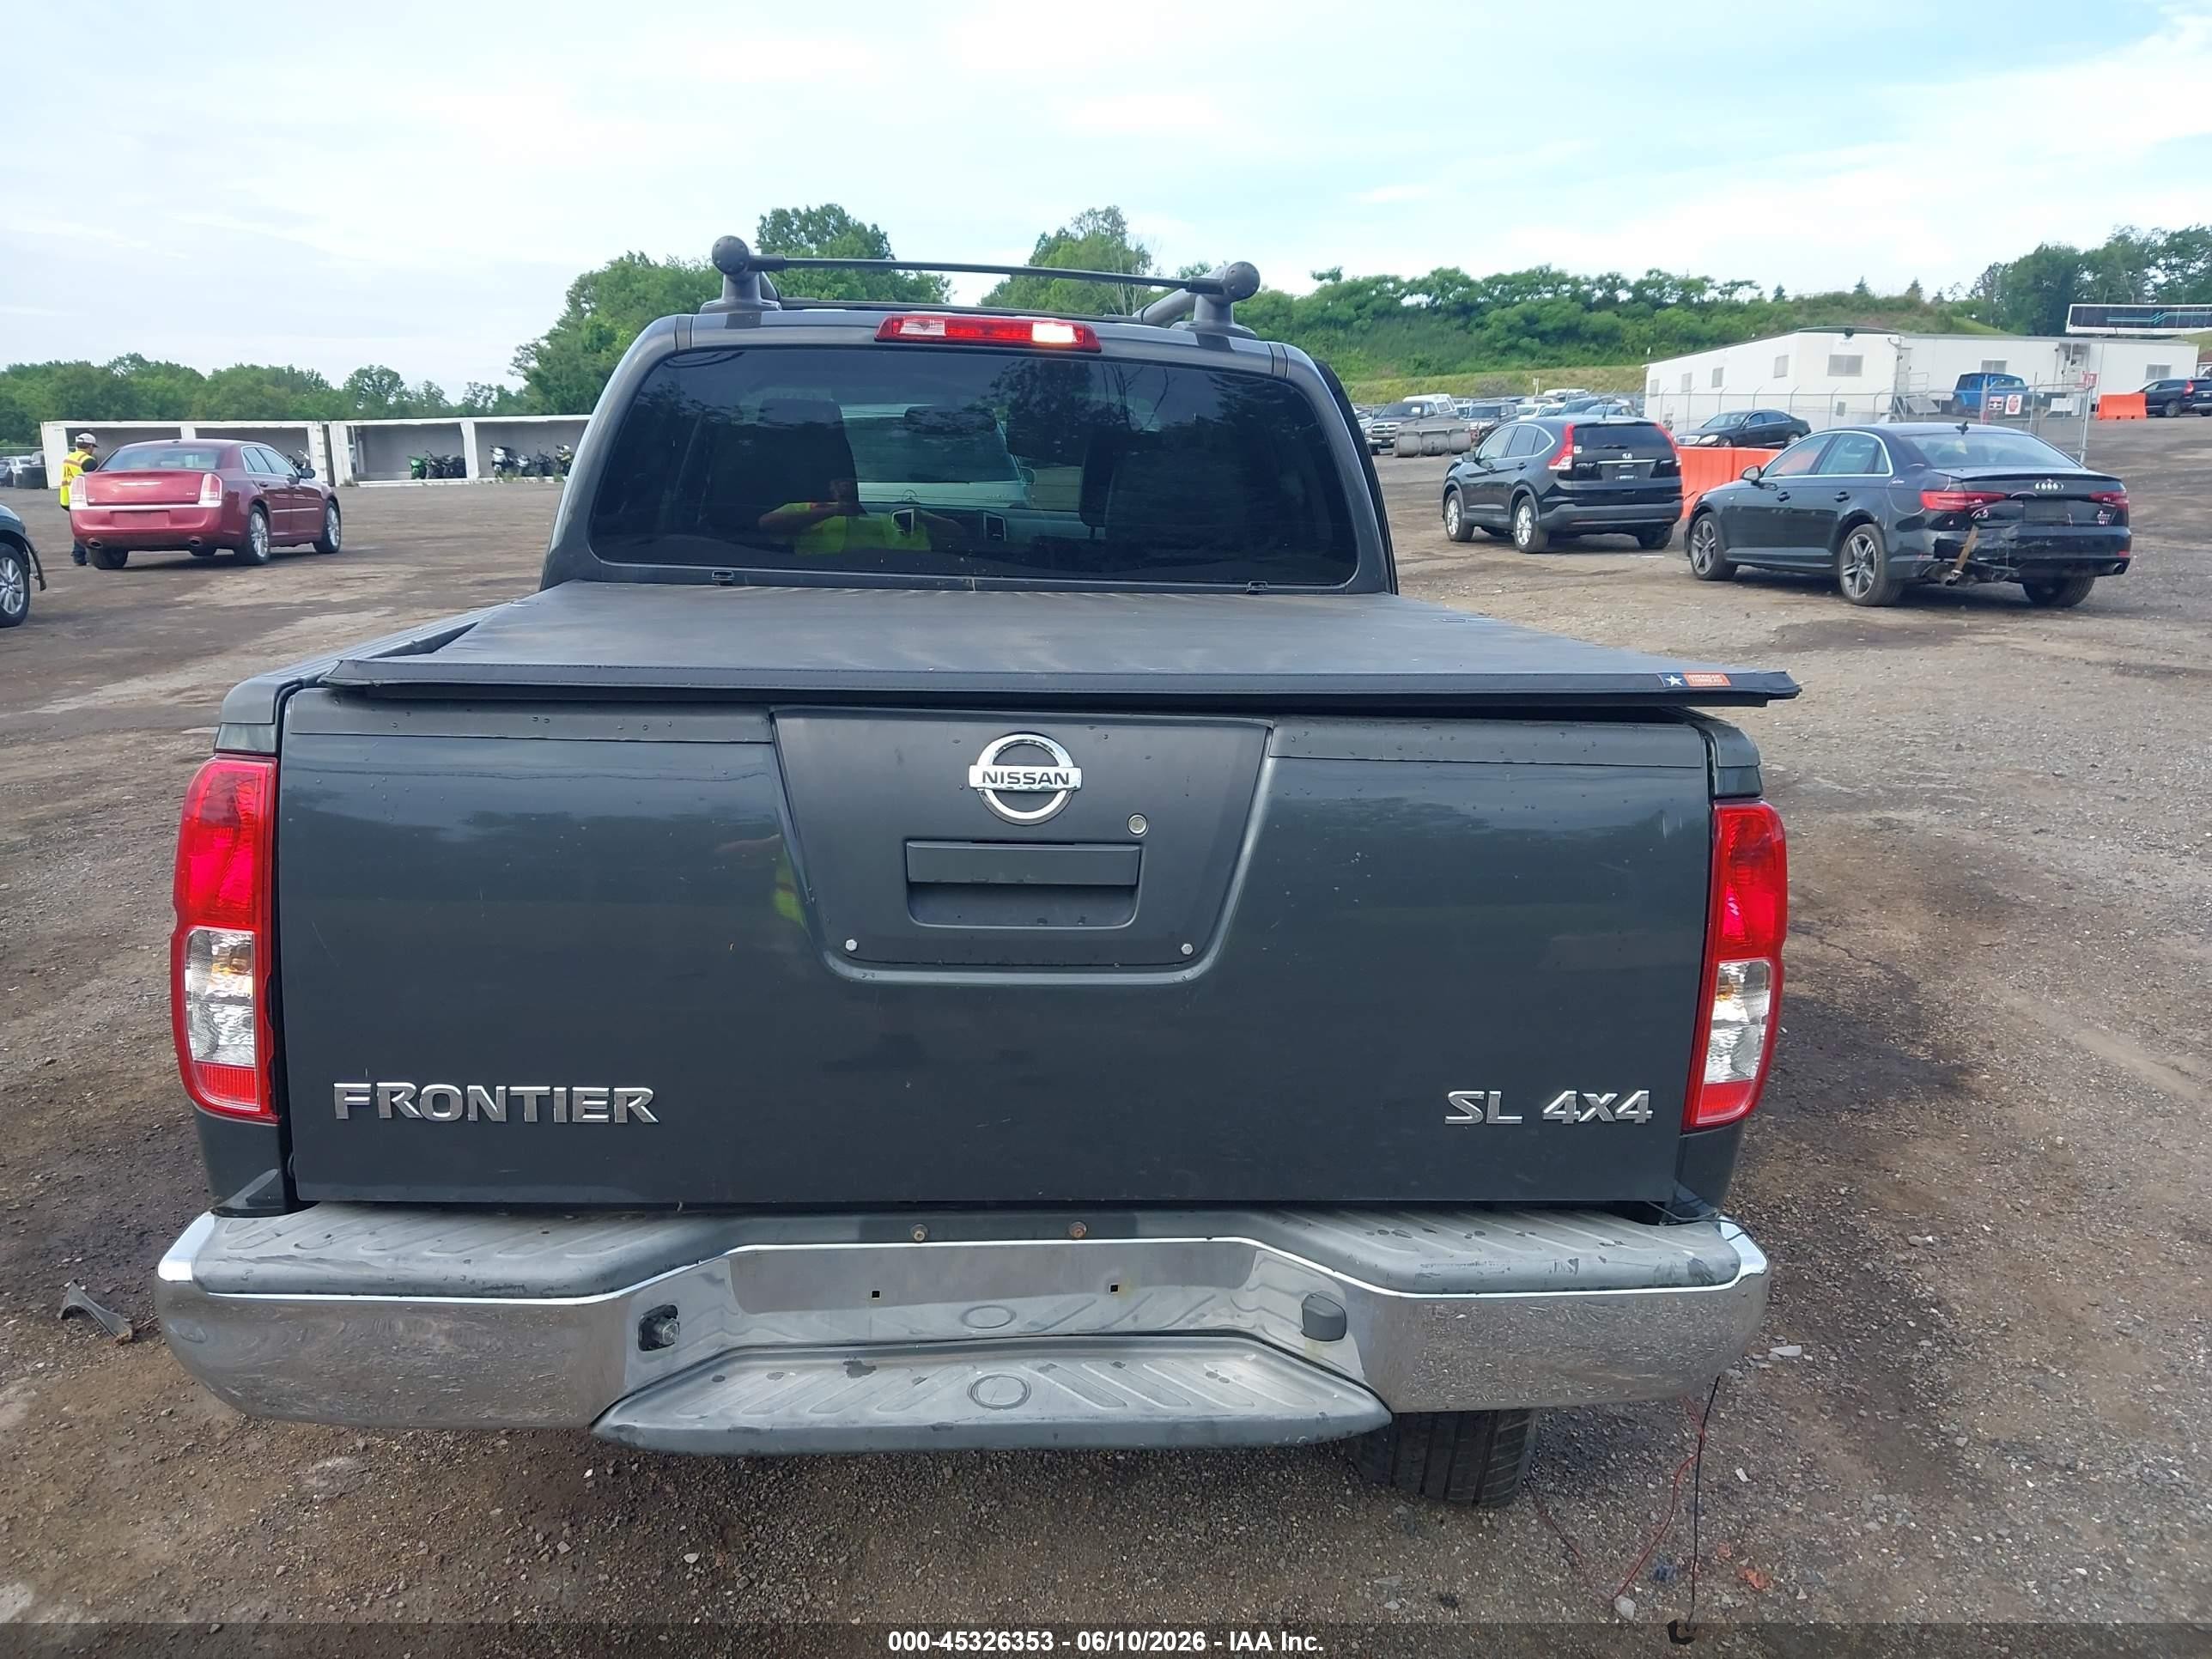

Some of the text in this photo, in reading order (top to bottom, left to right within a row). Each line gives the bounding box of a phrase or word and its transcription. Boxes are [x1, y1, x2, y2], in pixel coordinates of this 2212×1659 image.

[982, 770, 1070, 786] NISSAN
[333, 1082, 659, 1123] FRONTIER
[1444, 1091, 1523, 1125] SL
